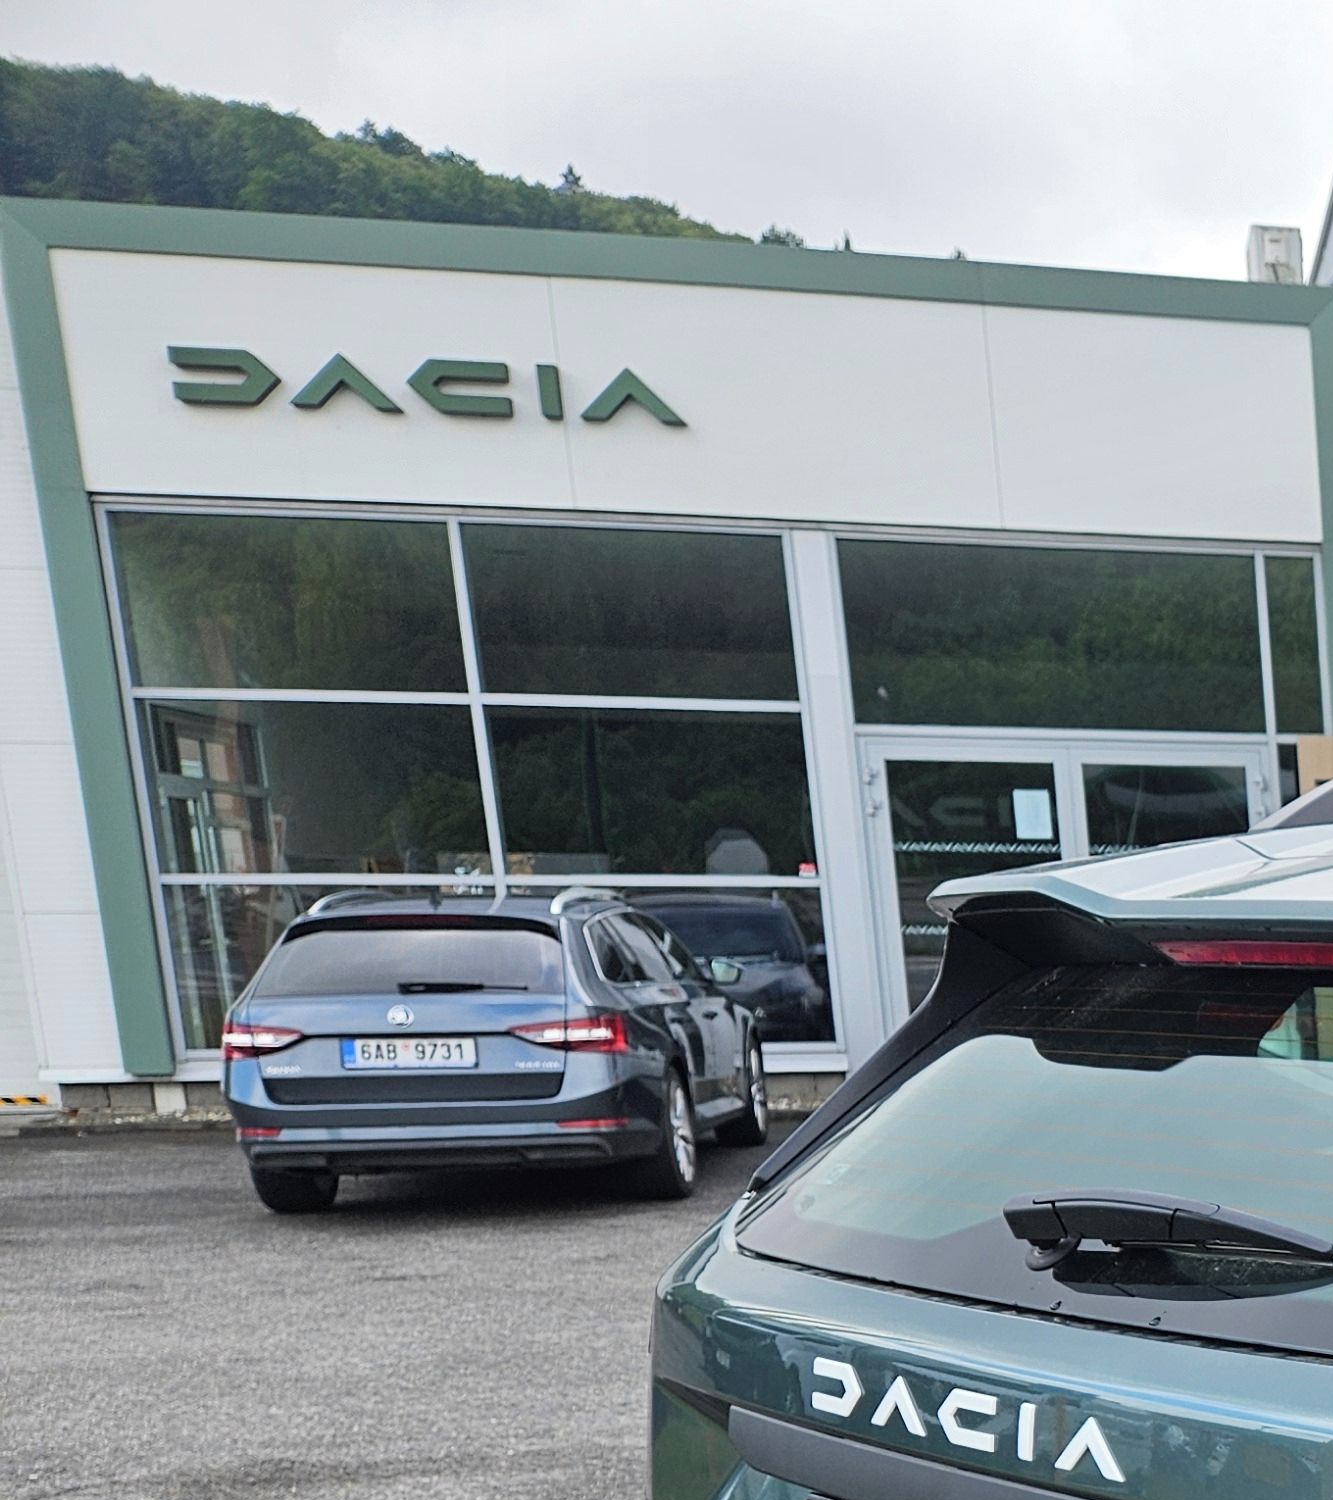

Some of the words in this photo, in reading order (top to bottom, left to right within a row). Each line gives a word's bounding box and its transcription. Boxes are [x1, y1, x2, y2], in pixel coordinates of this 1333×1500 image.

[167, 344, 688, 429] DACIA
[360, 1042, 398, 1061] 6AB
[414, 1042, 465, 1061] 9731
[809, 1356, 1127, 1483] DACIA
